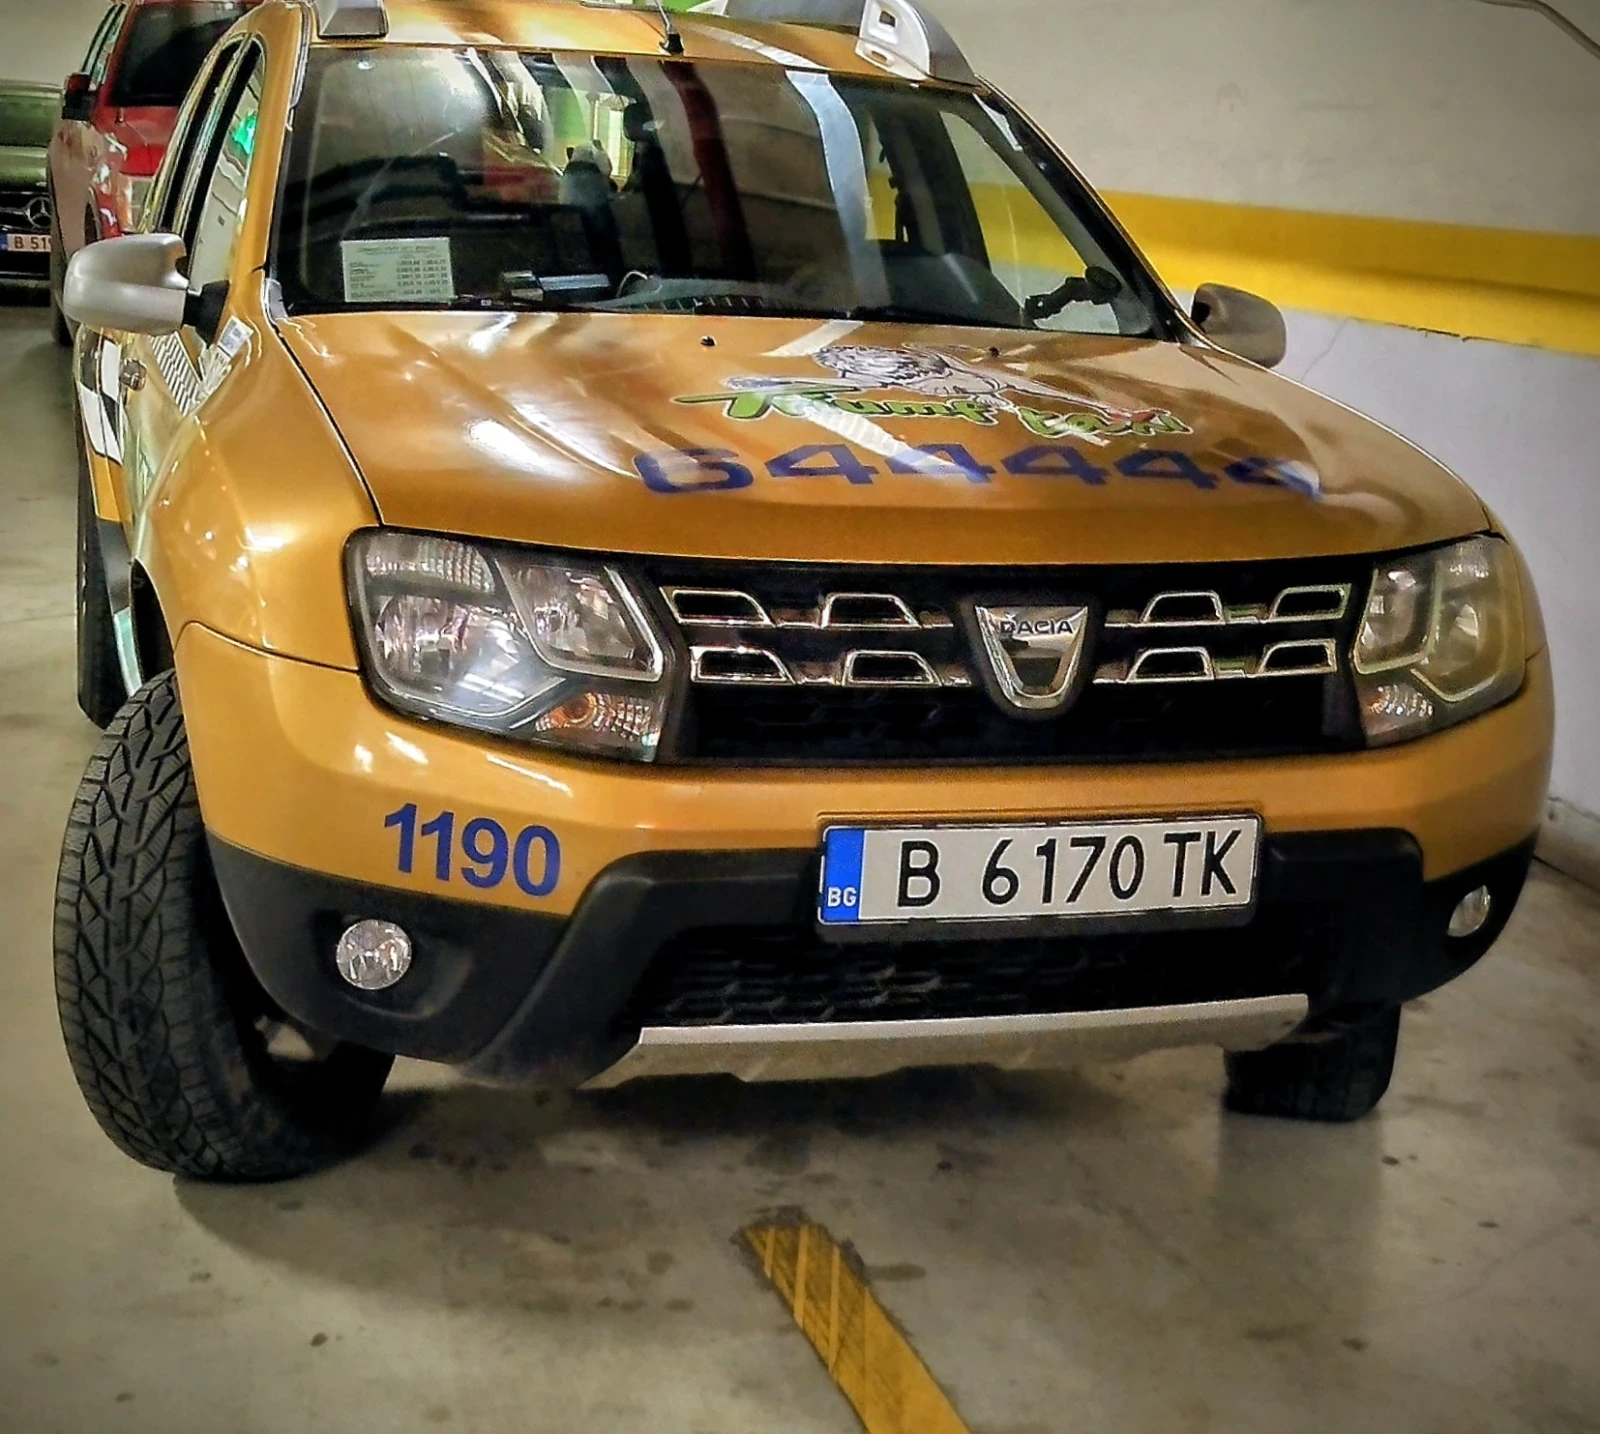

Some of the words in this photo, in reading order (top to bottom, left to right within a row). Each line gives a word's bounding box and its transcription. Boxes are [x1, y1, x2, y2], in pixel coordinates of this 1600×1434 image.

[14, 236, 24, 249] B
[30, 236, 52, 250] 51
[633, 443, 1326, 500] 644444
[1000, 619, 1073, 634] DACIA
[384, 802, 561, 897] 1190
[827, 886, 857, 907] BG
[897, 839, 941, 908] B
[982, 835, 1145, 905] 6170
[1163, 829, 1242, 898] TK
